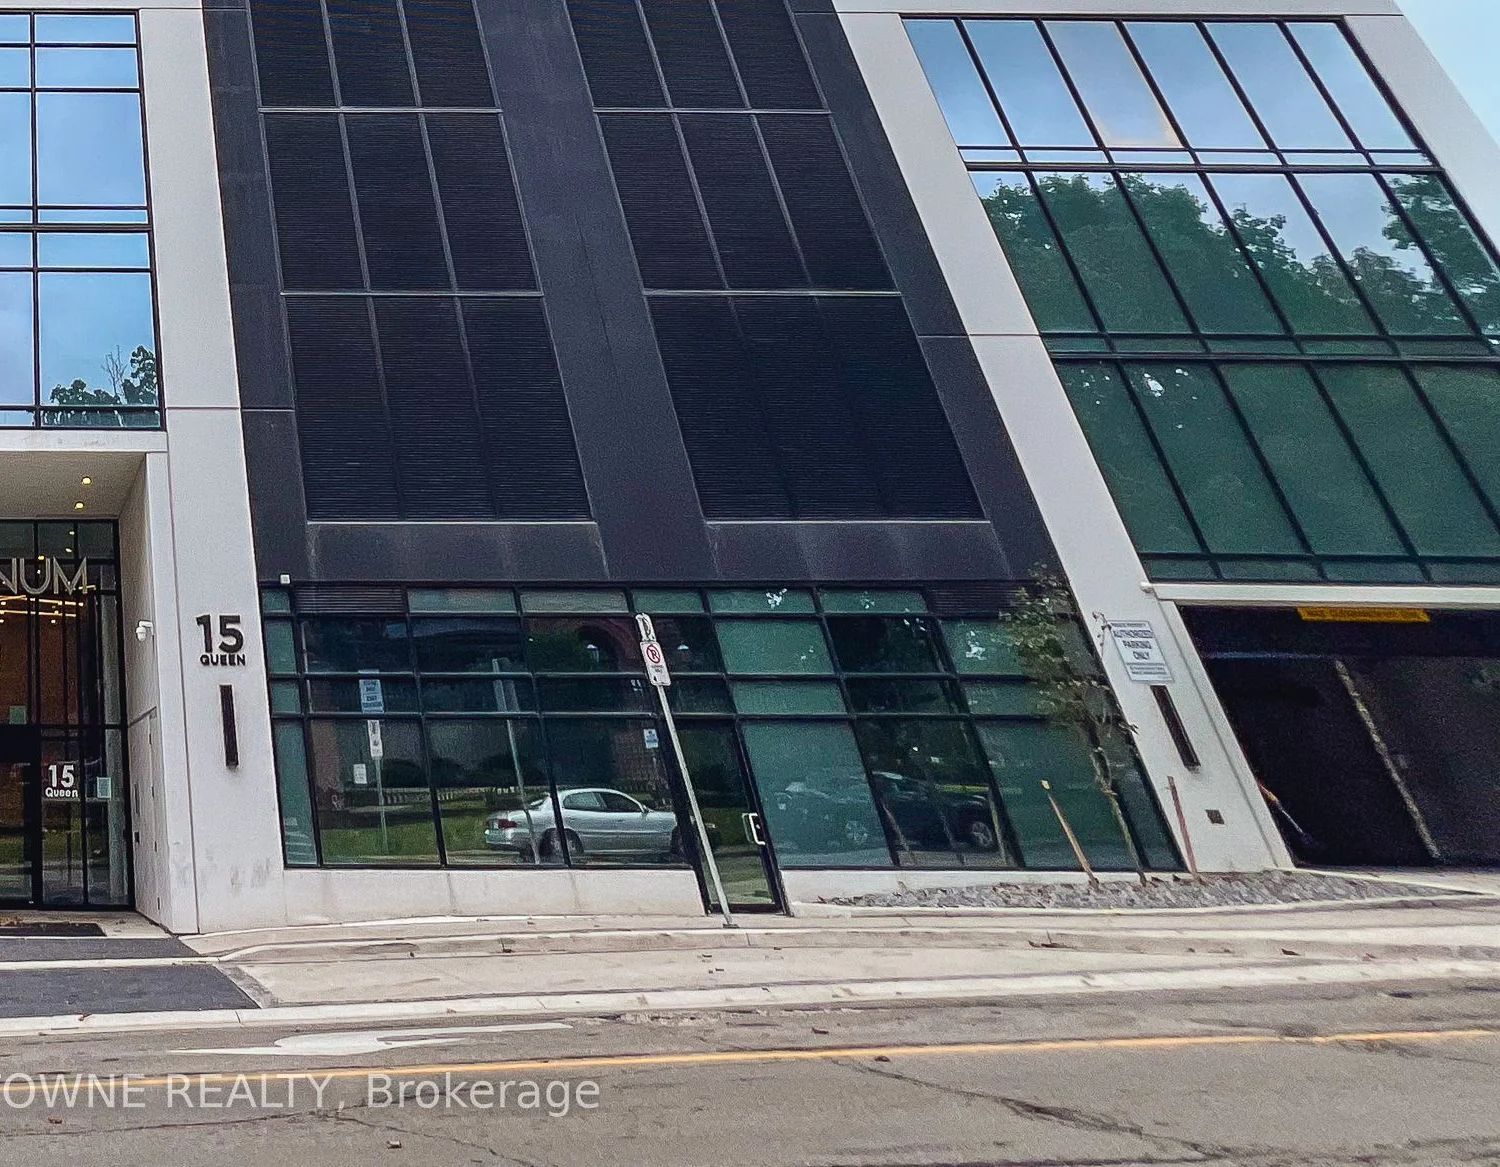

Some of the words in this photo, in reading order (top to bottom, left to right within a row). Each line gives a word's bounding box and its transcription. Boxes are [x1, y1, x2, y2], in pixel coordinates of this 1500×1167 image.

[196, 614, 244, 653] 15
[200, 653, 246, 667] QUEEN
[48, 764, 75, 788] 15
[44, 787, 79, 798] Queen
